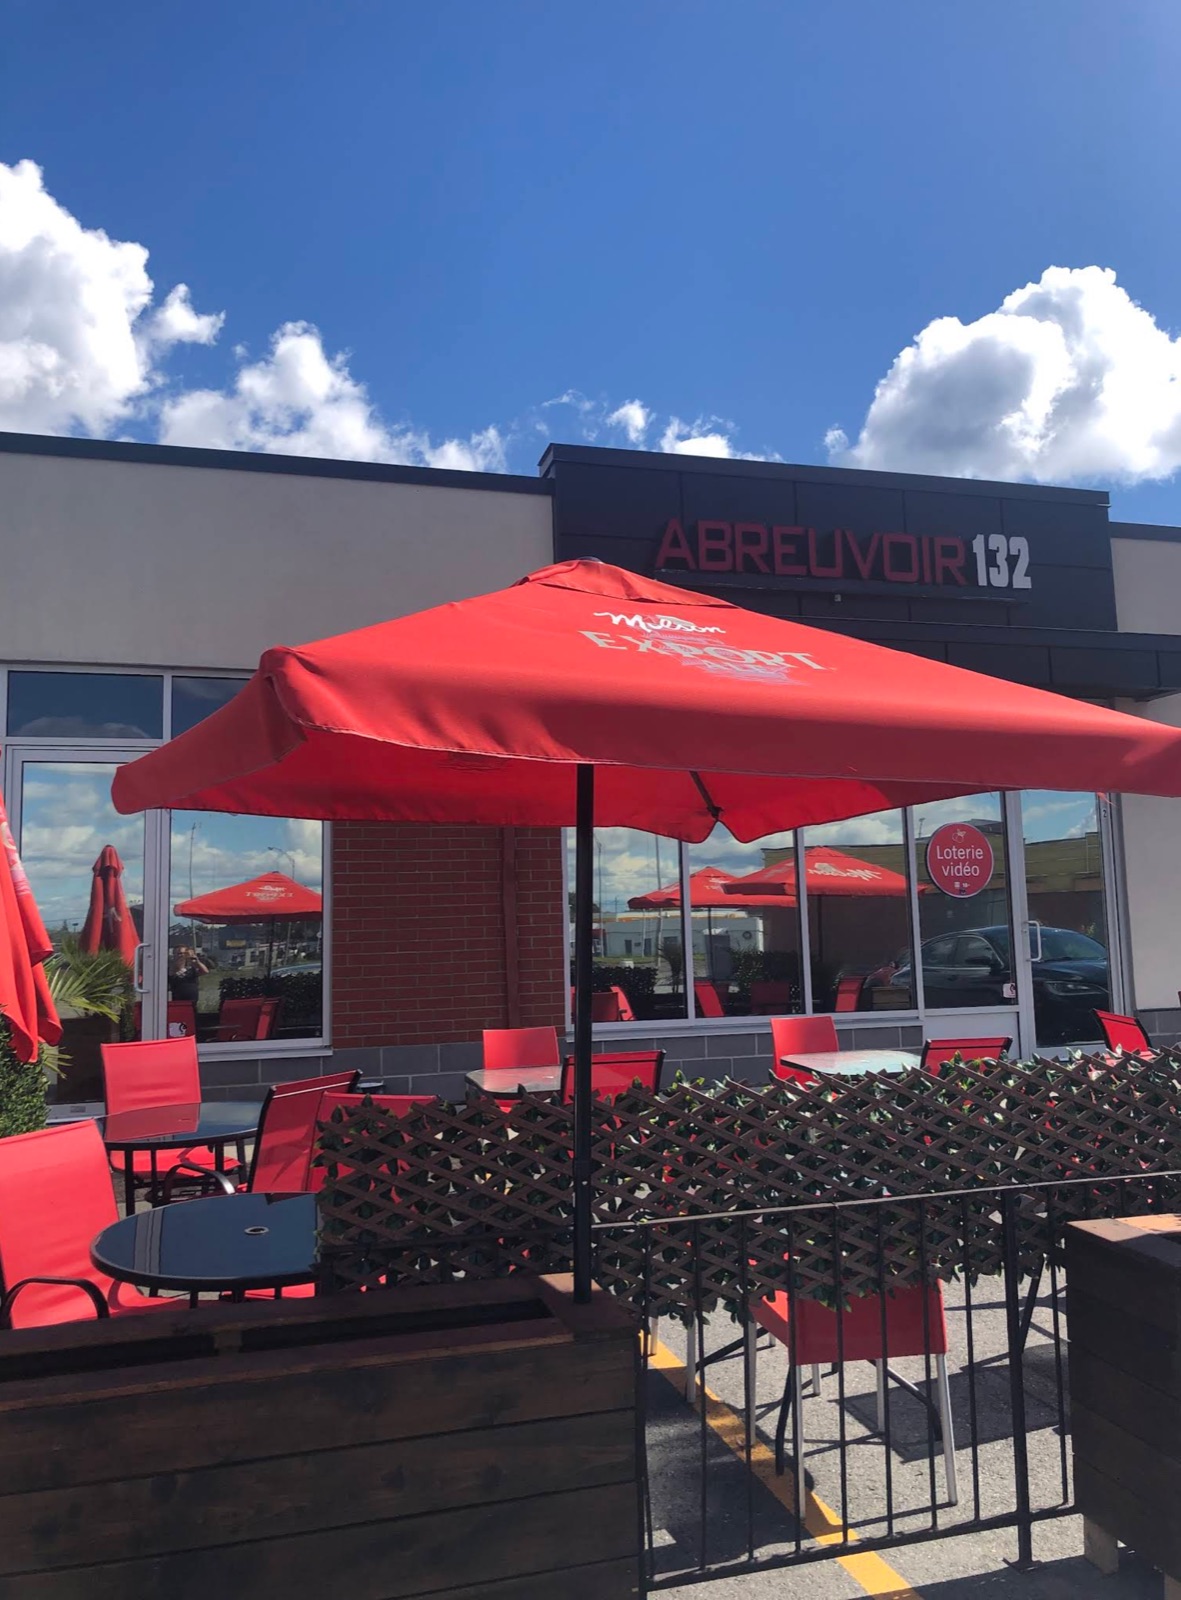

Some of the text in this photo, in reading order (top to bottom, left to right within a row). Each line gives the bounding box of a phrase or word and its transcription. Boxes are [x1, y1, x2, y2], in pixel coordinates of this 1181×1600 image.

[655, 518, 1032, 589] ABREUVOIR 132
[578, 630, 828, 670] EXPORT
[936, 845, 984, 859] Loterie
[941, 861, 980, 877] vidéo
